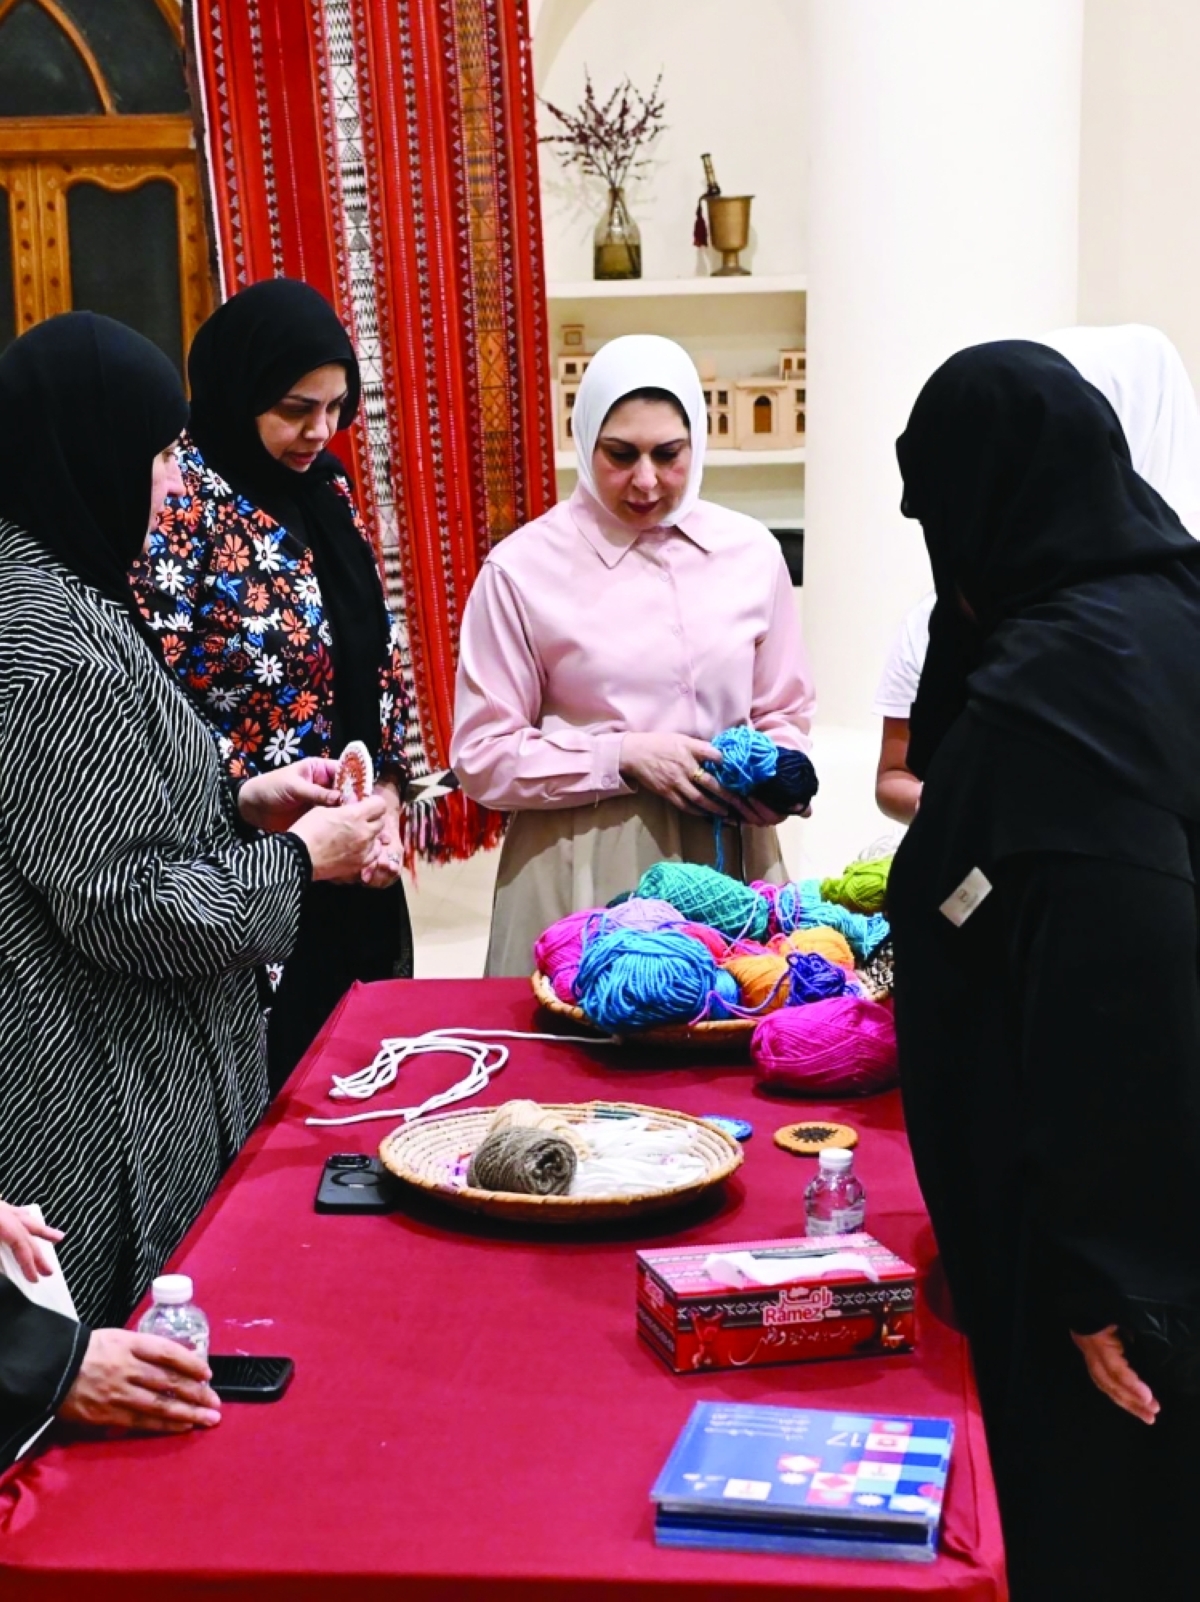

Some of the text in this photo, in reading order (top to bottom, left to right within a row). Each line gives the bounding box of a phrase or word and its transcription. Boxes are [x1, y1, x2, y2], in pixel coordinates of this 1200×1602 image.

[780, 1287, 832, 1308] رامز
[765, 1307, 822, 1323] Ramez
[826, 1432, 862, 1448] 17
